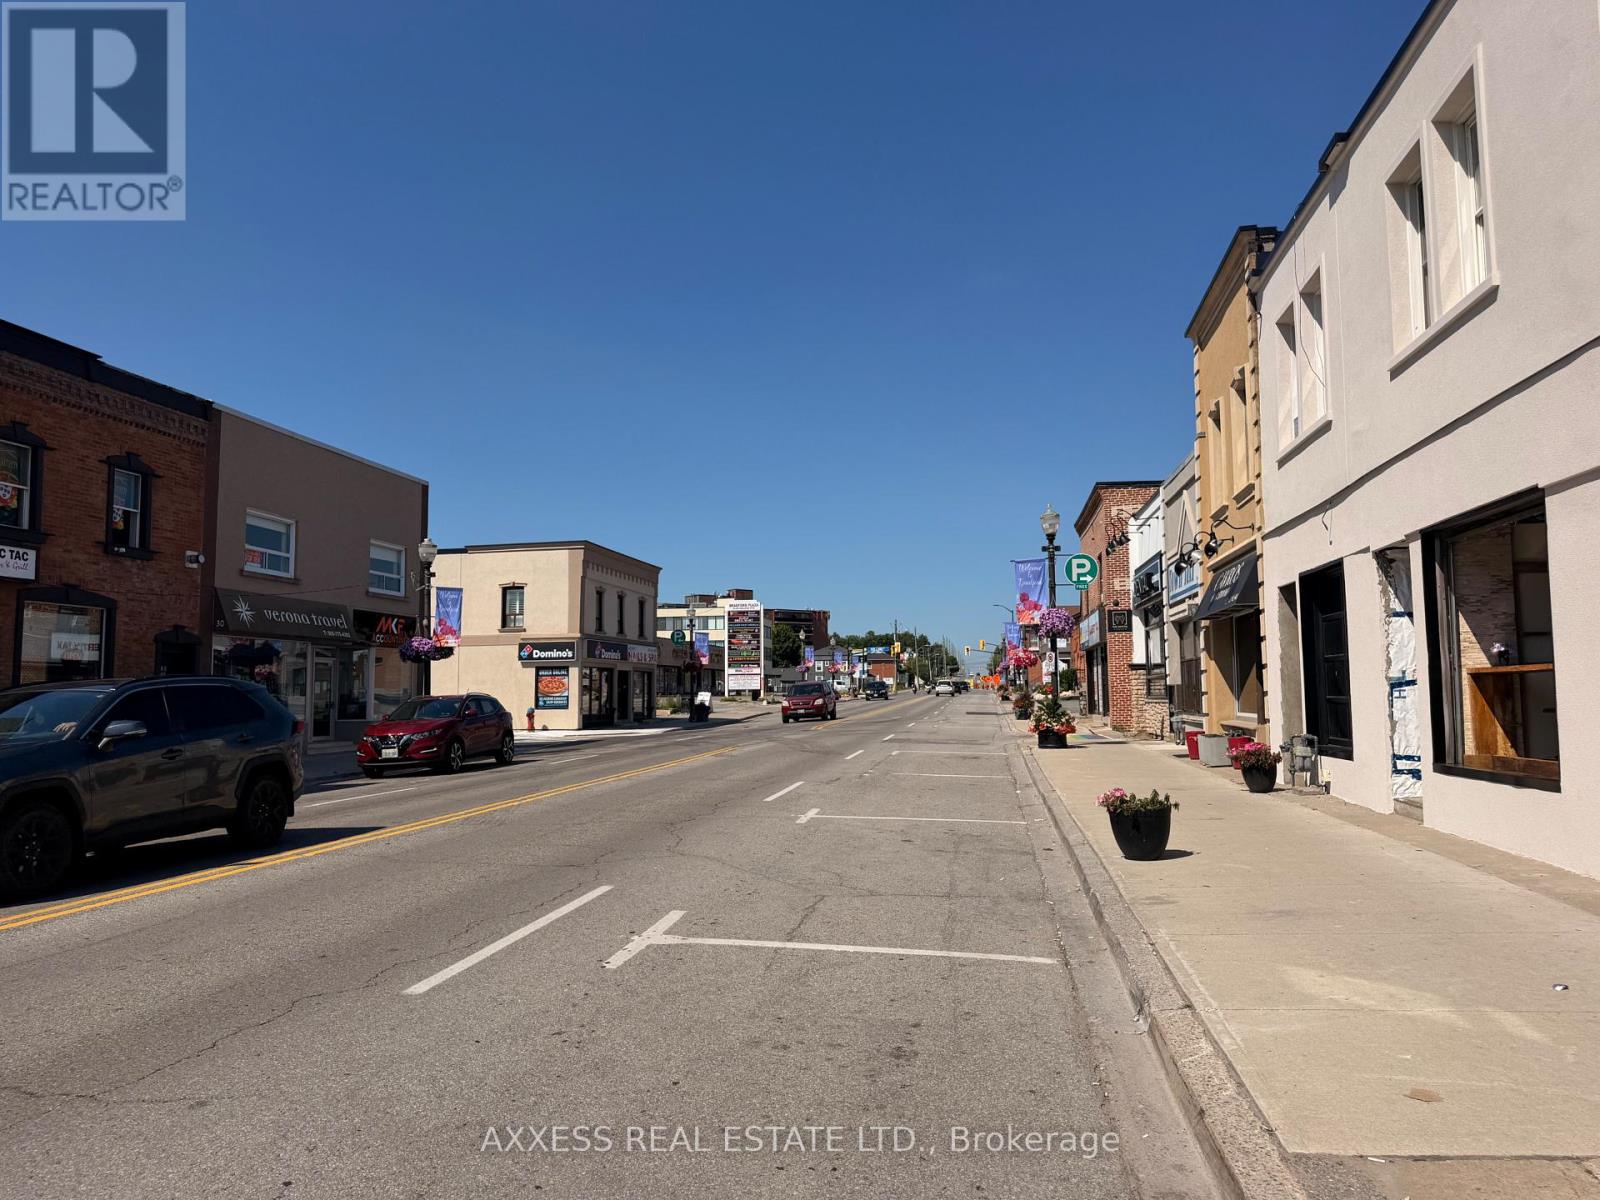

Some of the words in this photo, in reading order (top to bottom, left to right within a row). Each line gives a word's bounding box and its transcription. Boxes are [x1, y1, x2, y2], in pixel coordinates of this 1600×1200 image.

[9, 549, 29, 561] TAC
[1072, 559, 1091, 581] P
[264, 608, 311, 625] verona
[311, 613, 348, 629] travel
[533, 648, 573, 658] Domino's
[601, 648, 621, 660] Domino's
